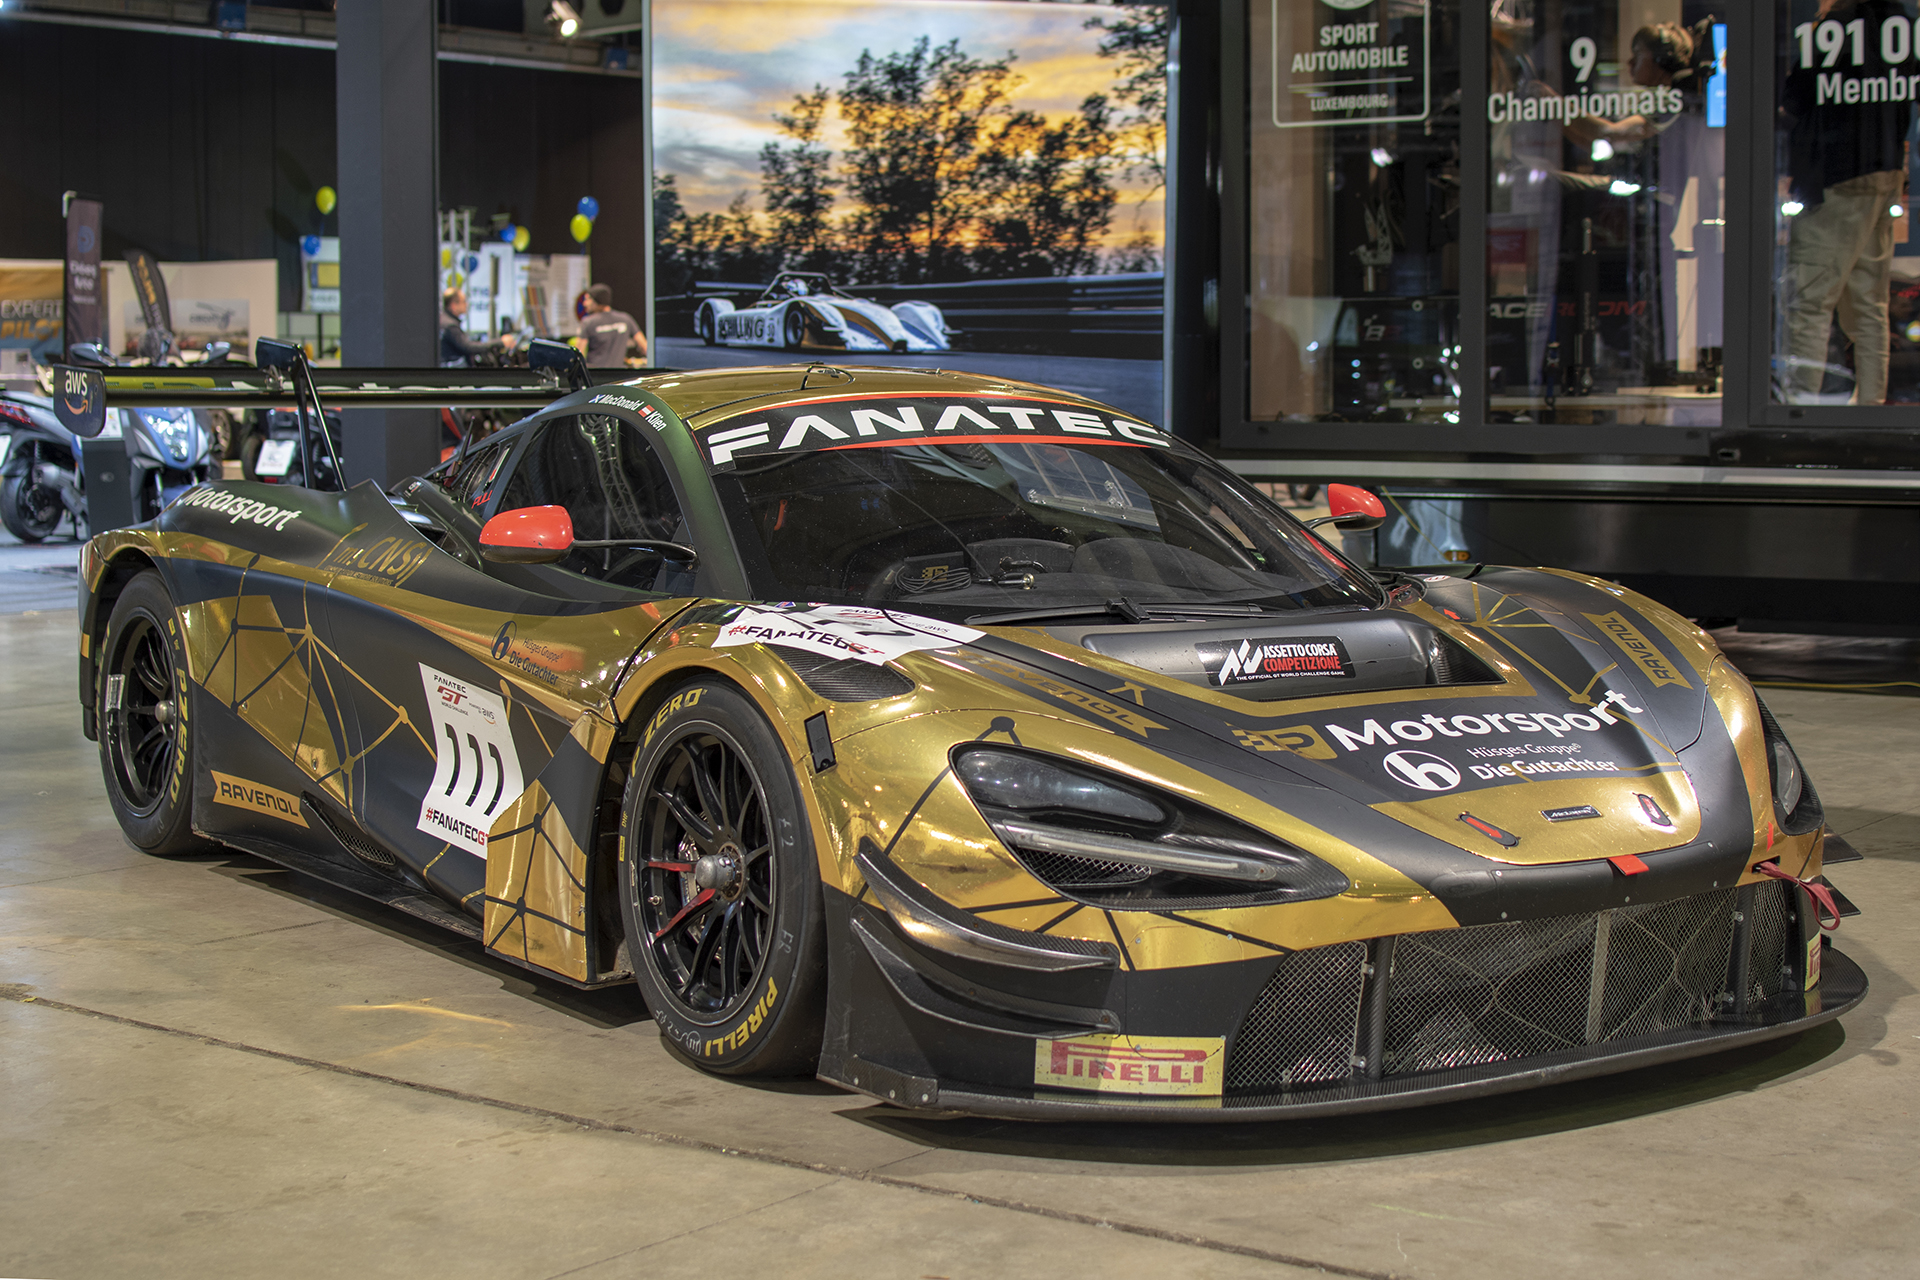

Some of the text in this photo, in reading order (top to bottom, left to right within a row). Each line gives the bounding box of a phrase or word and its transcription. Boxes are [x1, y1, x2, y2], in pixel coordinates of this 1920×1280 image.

[1319, 22, 1379, 46] SPORT
[1794, 18, 1865, 69] 191
[1291, 45, 1409, 73] AUTOMOBILE
[1569, 36, 1597, 83] 9
[1310, 93, 1389, 112] LUXEMBOURG
[1487, 84, 1684, 126] Championnats
[1, 299, 63, 318] EXPERT
[1, 318, 63, 341] PILOT
[65, 369, 88, 398] aws
[598, 394, 645, 412] MacDonald
[645, 410, 667, 432] Klien
[707, 406, 1171, 466] FANATEC
[176, 486, 303, 532] Motorsport
[1263, 642, 1337, 659] ASSETTO CORSA
[1600, 616, 1677, 681] RAVENOL
[509, 650, 559, 686] Die Gutachter
[1263, 655, 1342, 673] COMPETIZIONE
[433, 674, 467, 694] FANATEC
[644, 688, 704, 748] ZERO
[1325, 689, 1643, 752] Motorsport
[1466, 744, 1528, 760] Hüsges
[444, 722, 505, 817] 111
[1468, 757, 1621, 781] Die Gutachter
[220, 781, 300, 817] RAVENOL
[1551, 808, 1592, 819] McLaren
[704, 976, 779, 1057] PIRELLI
[1050, 1041, 1207, 1083] PIRELLI
